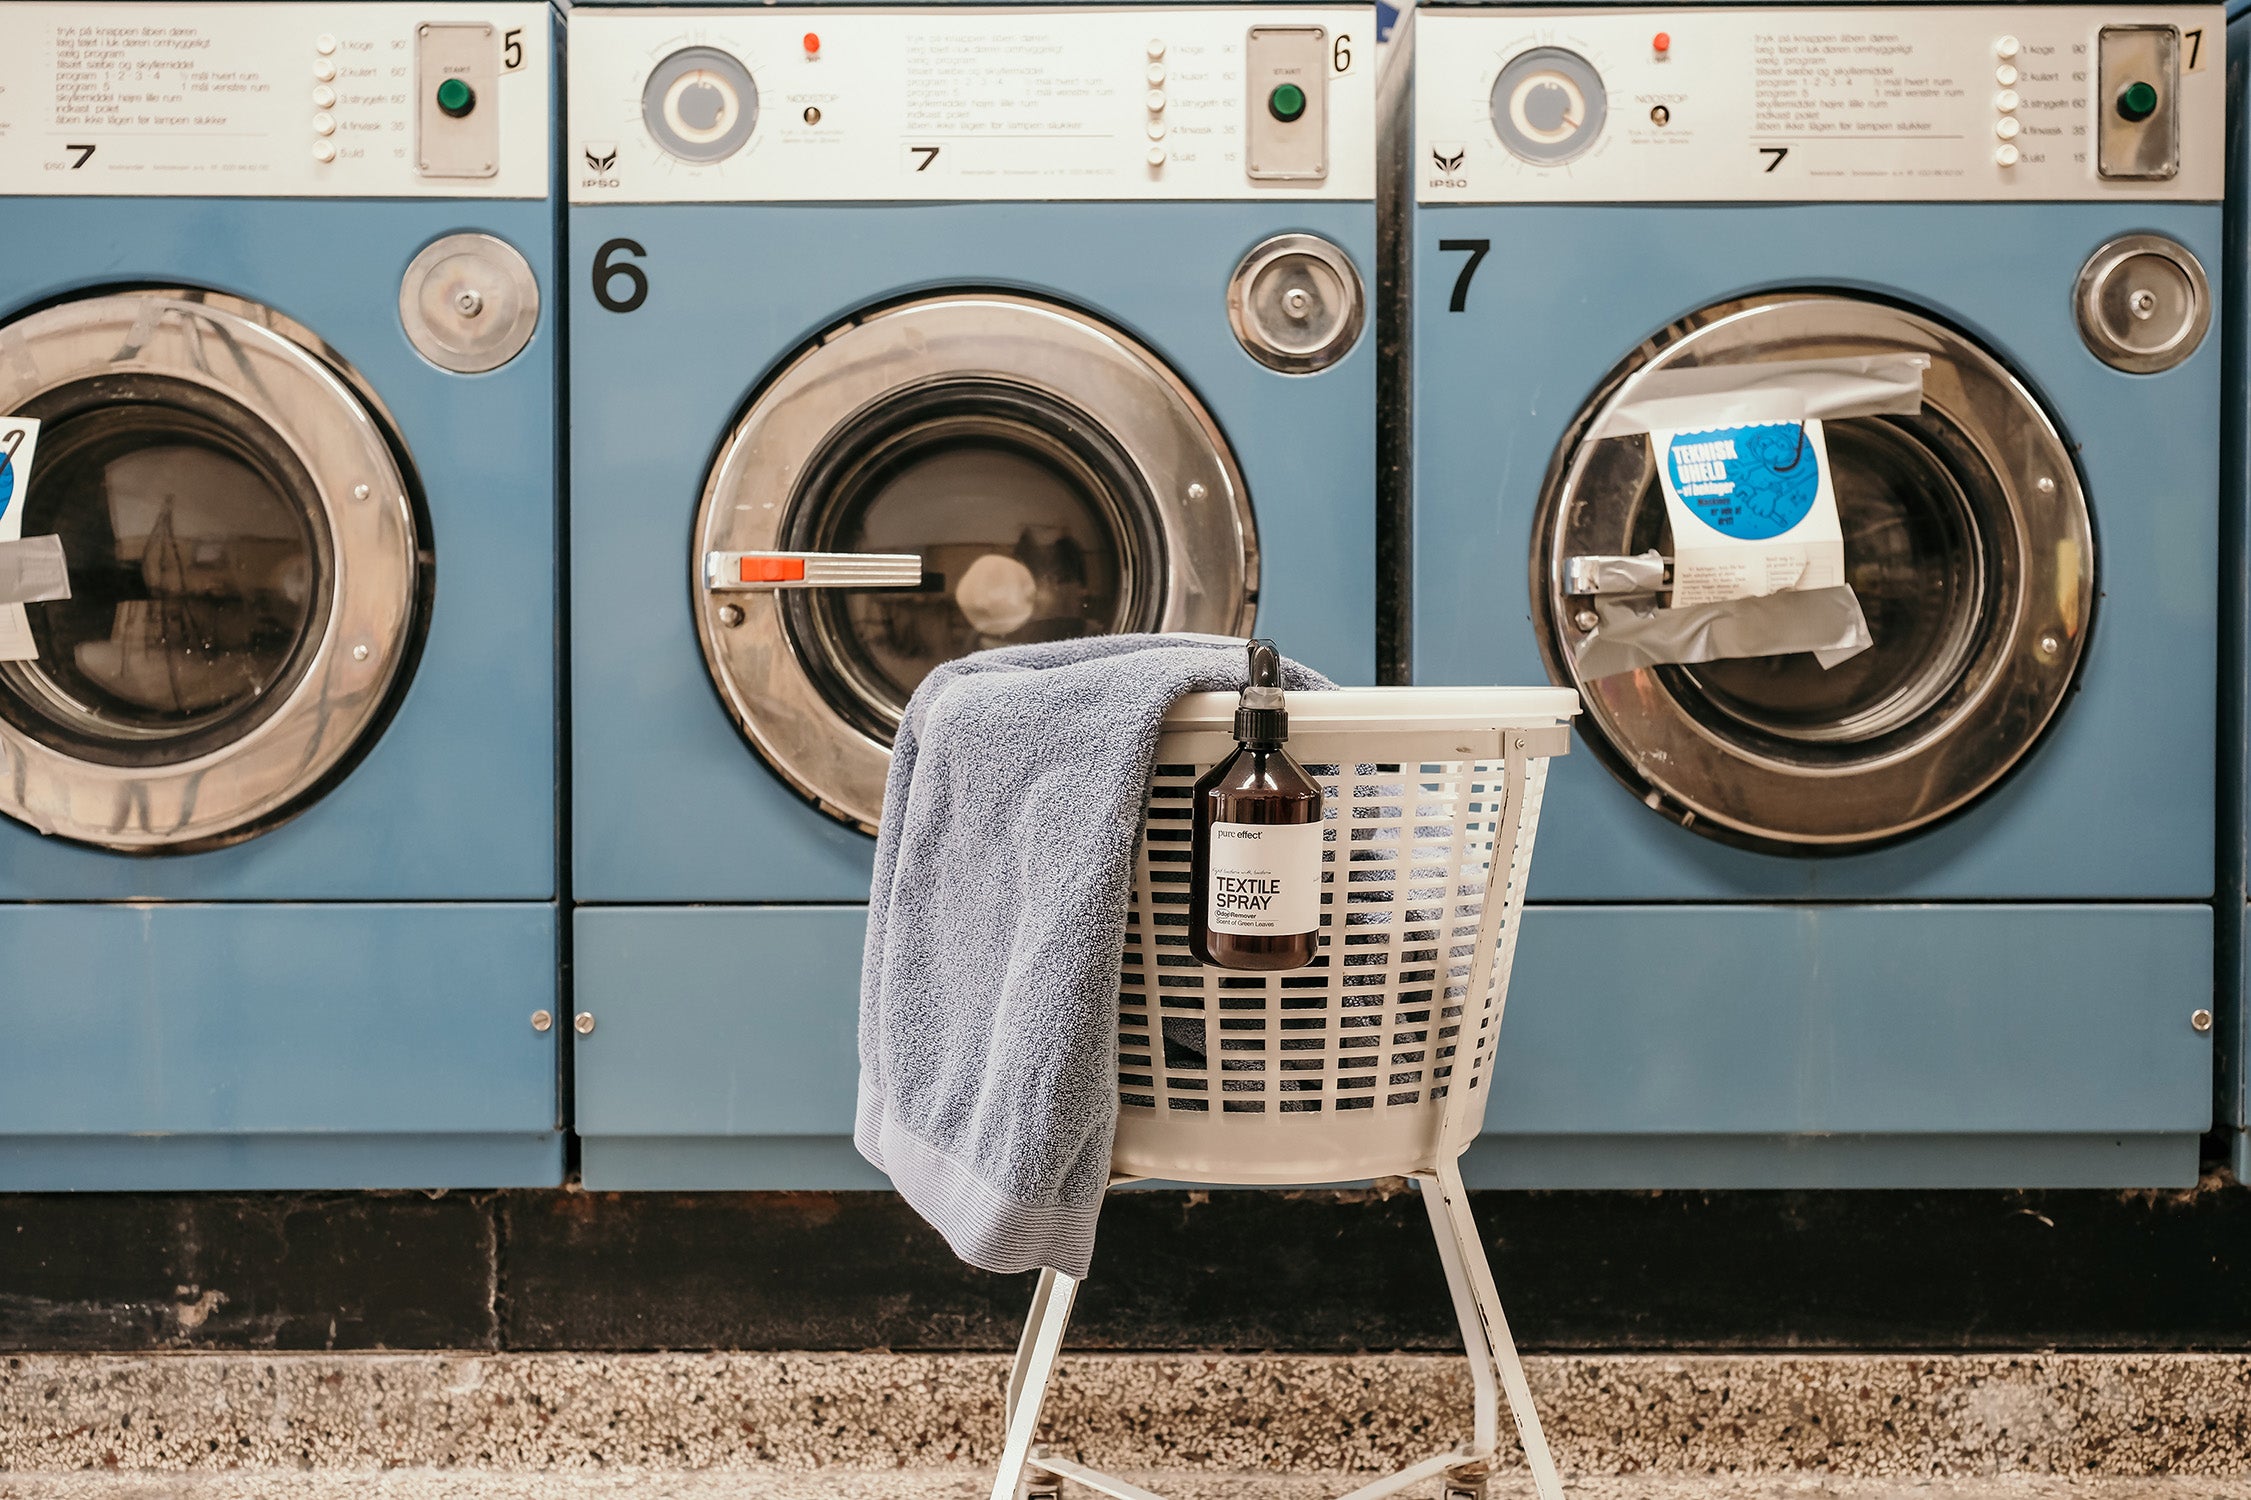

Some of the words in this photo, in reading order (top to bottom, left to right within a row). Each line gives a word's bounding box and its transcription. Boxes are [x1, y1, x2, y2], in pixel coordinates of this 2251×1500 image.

[505, 29, 522, 69] 5
[1333, 34, 1351, 72] 6
[66, 144, 96, 169] 7
[911, 147, 940, 172] 7
[1759, 148, 1789, 173] 7
[581, 179, 620, 188] IPSO
[1429, 179, 1468, 188] IPSO
[592, 238, 648, 313] 6
[1439, 239, 1490, 312] 7
[1218, 830, 1236, 839] pure
[1216, 876, 1280, 894] TEXTILE
[1216, 893, 1272, 910] SPRAY
